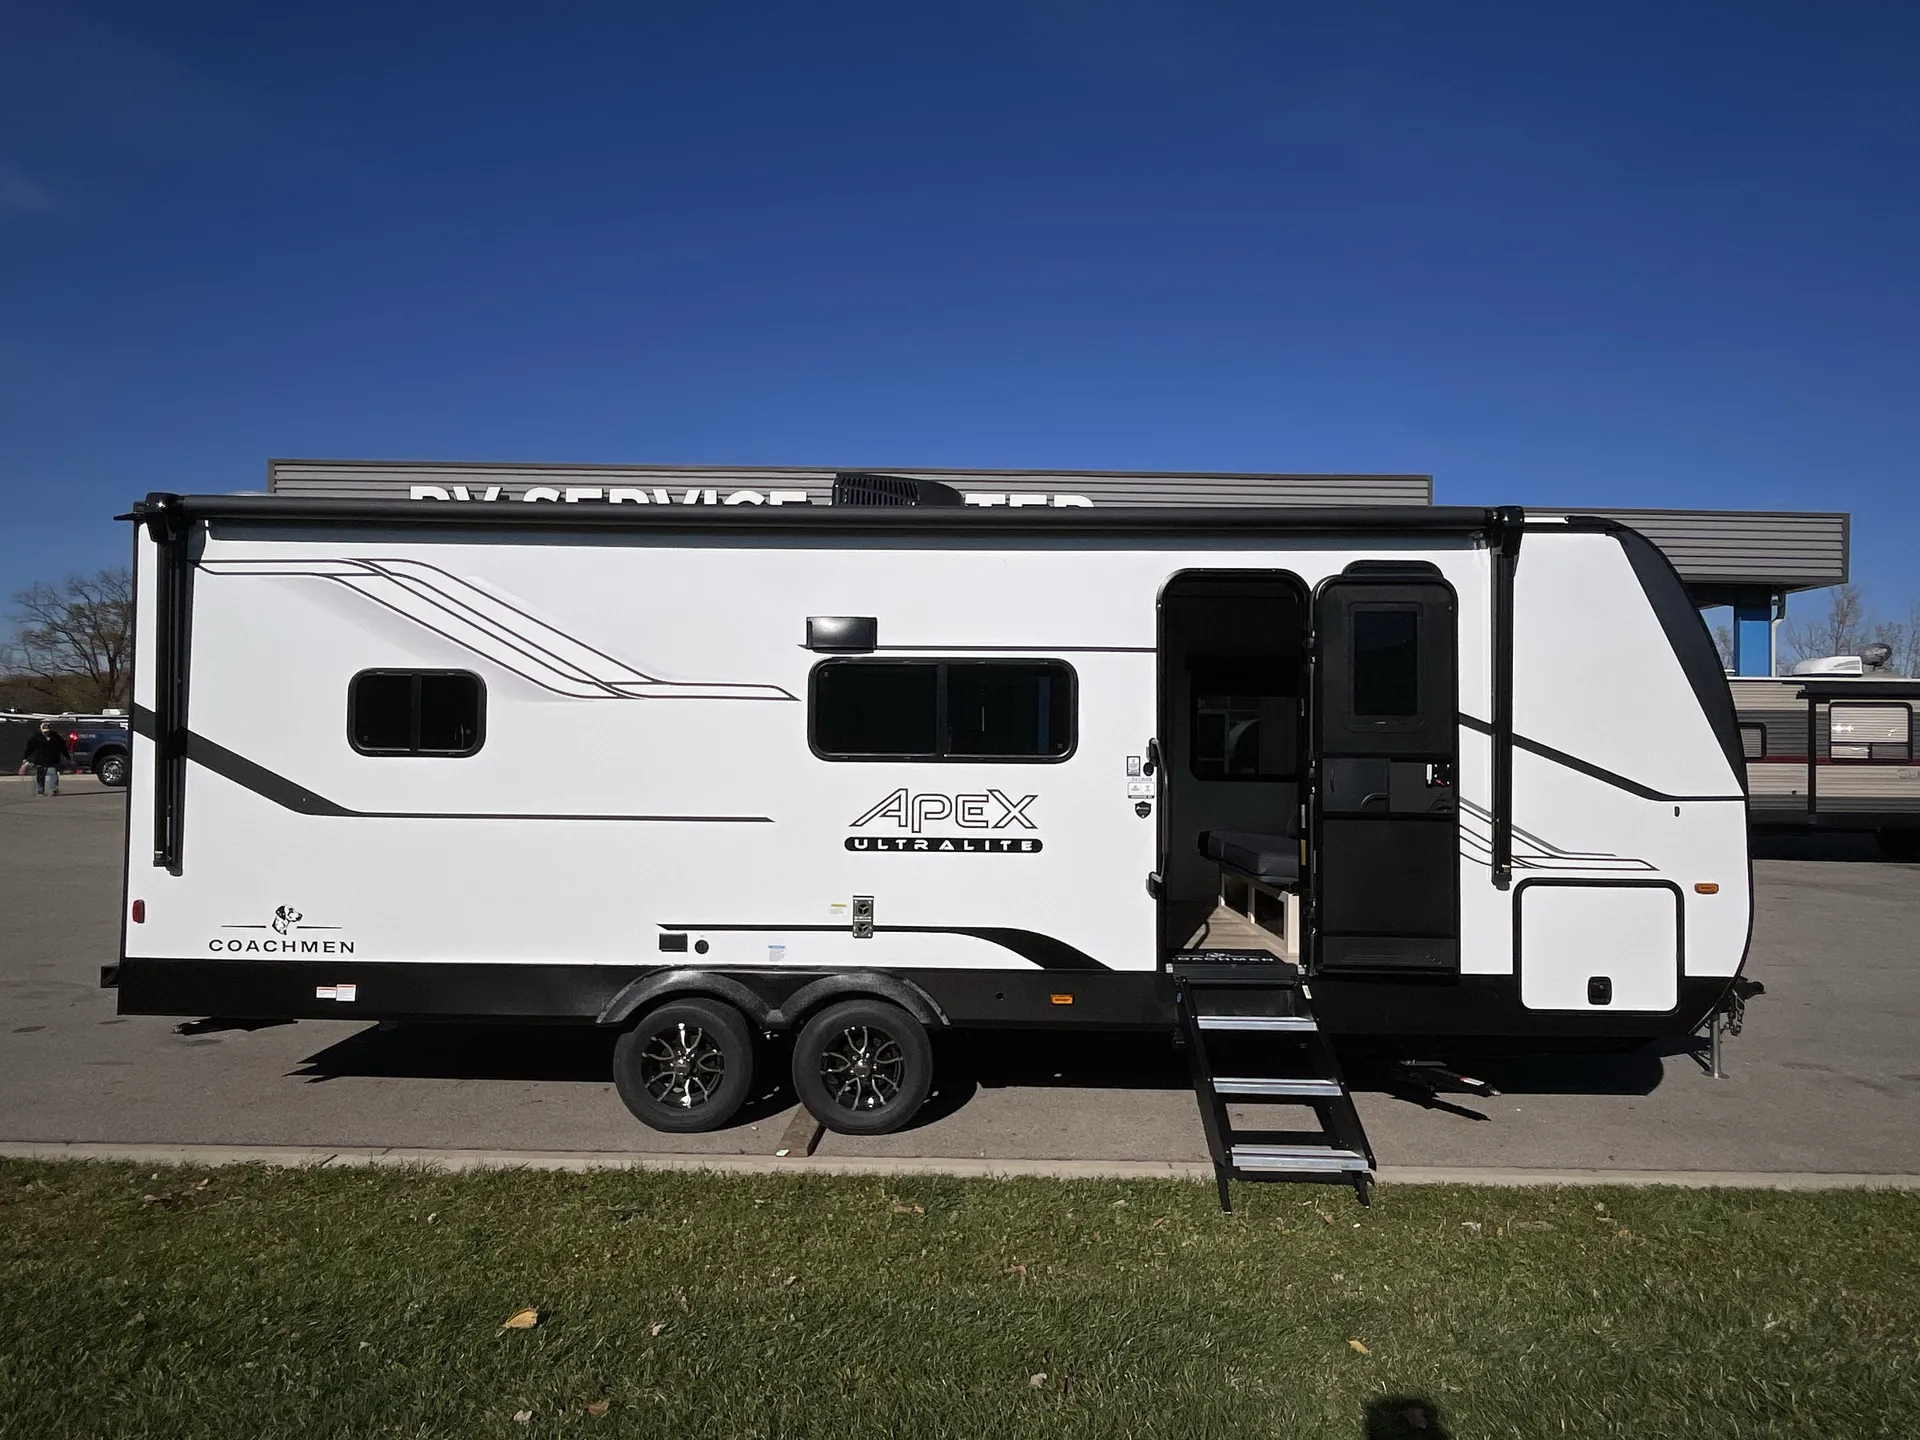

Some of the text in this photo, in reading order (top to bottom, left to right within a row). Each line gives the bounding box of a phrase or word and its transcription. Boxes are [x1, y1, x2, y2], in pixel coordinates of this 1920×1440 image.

[849, 788, 1039, 833] APEX
[854, 839, 1033, 851] ULTRALITE
[208, 939, 355, 953] COACHMEN
